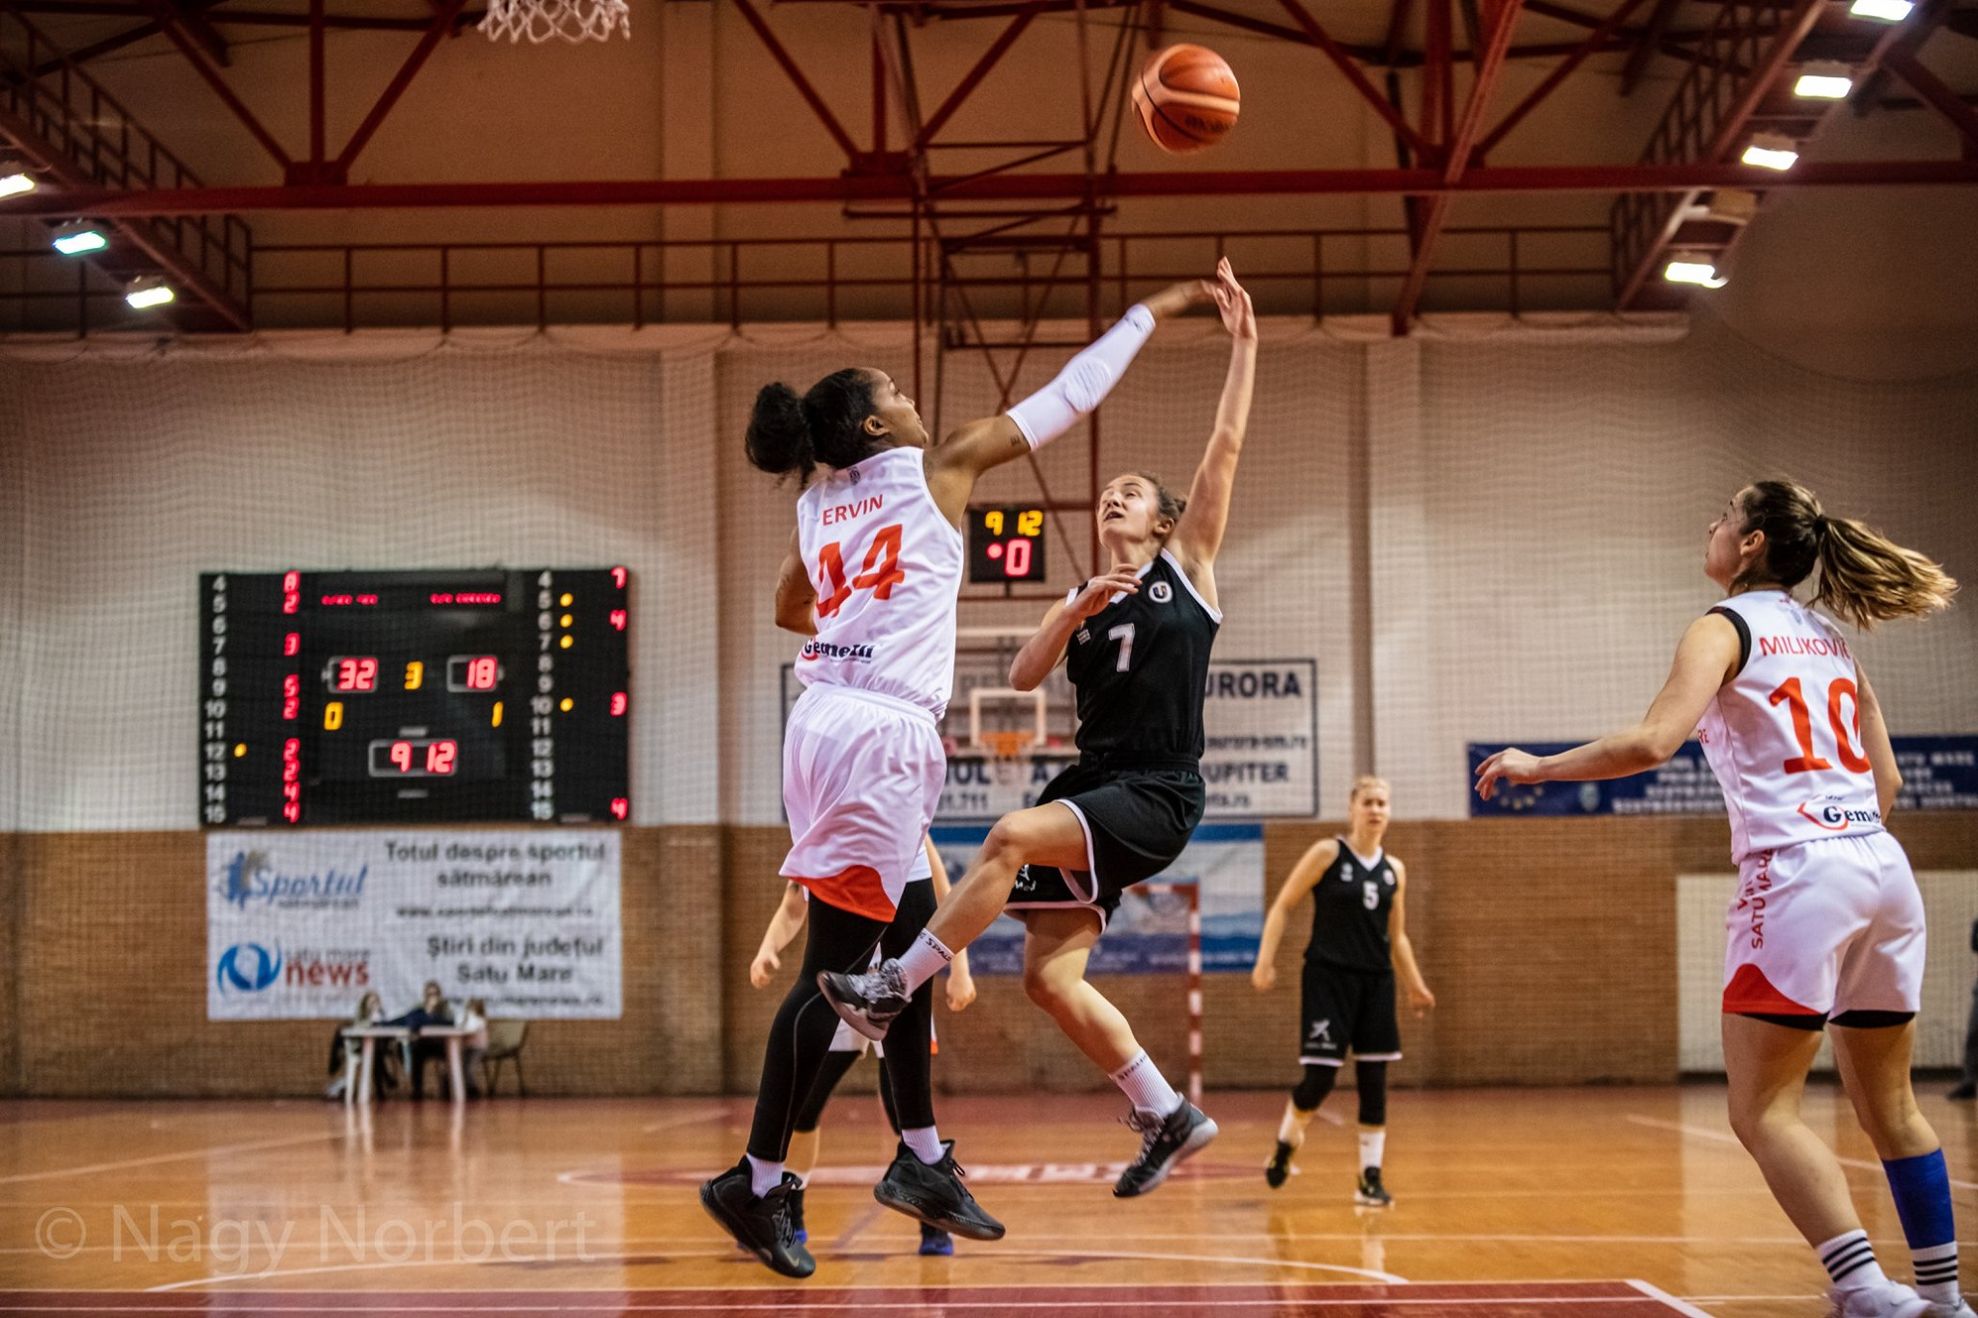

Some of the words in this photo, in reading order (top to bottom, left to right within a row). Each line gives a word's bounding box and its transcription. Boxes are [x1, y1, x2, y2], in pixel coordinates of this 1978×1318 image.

[823, 495, 883, 526] ERVIN
[985, 511, 1004, 536] 9
[1018, 510, 1043, 536] 12
[1005, 539, 1032, 577] 0
[212, 635, 226, 655] 7
[540, 632, 552, 650] 7
[1108, 623, 1136, 673] 7
[284, 674, 300, 697] 5
[338, 658, 377, 690] 32
[405, 661, 423, 690] 3
[467, 657, 497, 689] 18
[1206, 672, 1301, 698] URORA
[206, 699, 226, 718] 10
[283, 697, 300, 719] 2
[324, 702, 343, 731] 0
[492, 702, 503, 728] 1
[532, 695, 553, 715] 10
[206, 720, 224, 739] 11
[532, 716, 551, 735] 11
[1769, 677, 1872, 774] 10
[283, 739, 300, 760] 2
[391, 740, 411, 773] 9
[427, 740, 456, 774] 12
[283, 760, 300, 781] 2
[386, 842, 437, 862] Totul
[446, 843, 520, 864] despre
[527, 843, 605, 864] sportul
[1362, 881, 1379, 910] 5
[1751, 897, 1766, 949] SATU
[480, 937, 515, 955] din
[286, 961, 369, 985] news
[457, 963, 508, 983] Satu
[517, 963, 573, 983] Mare
